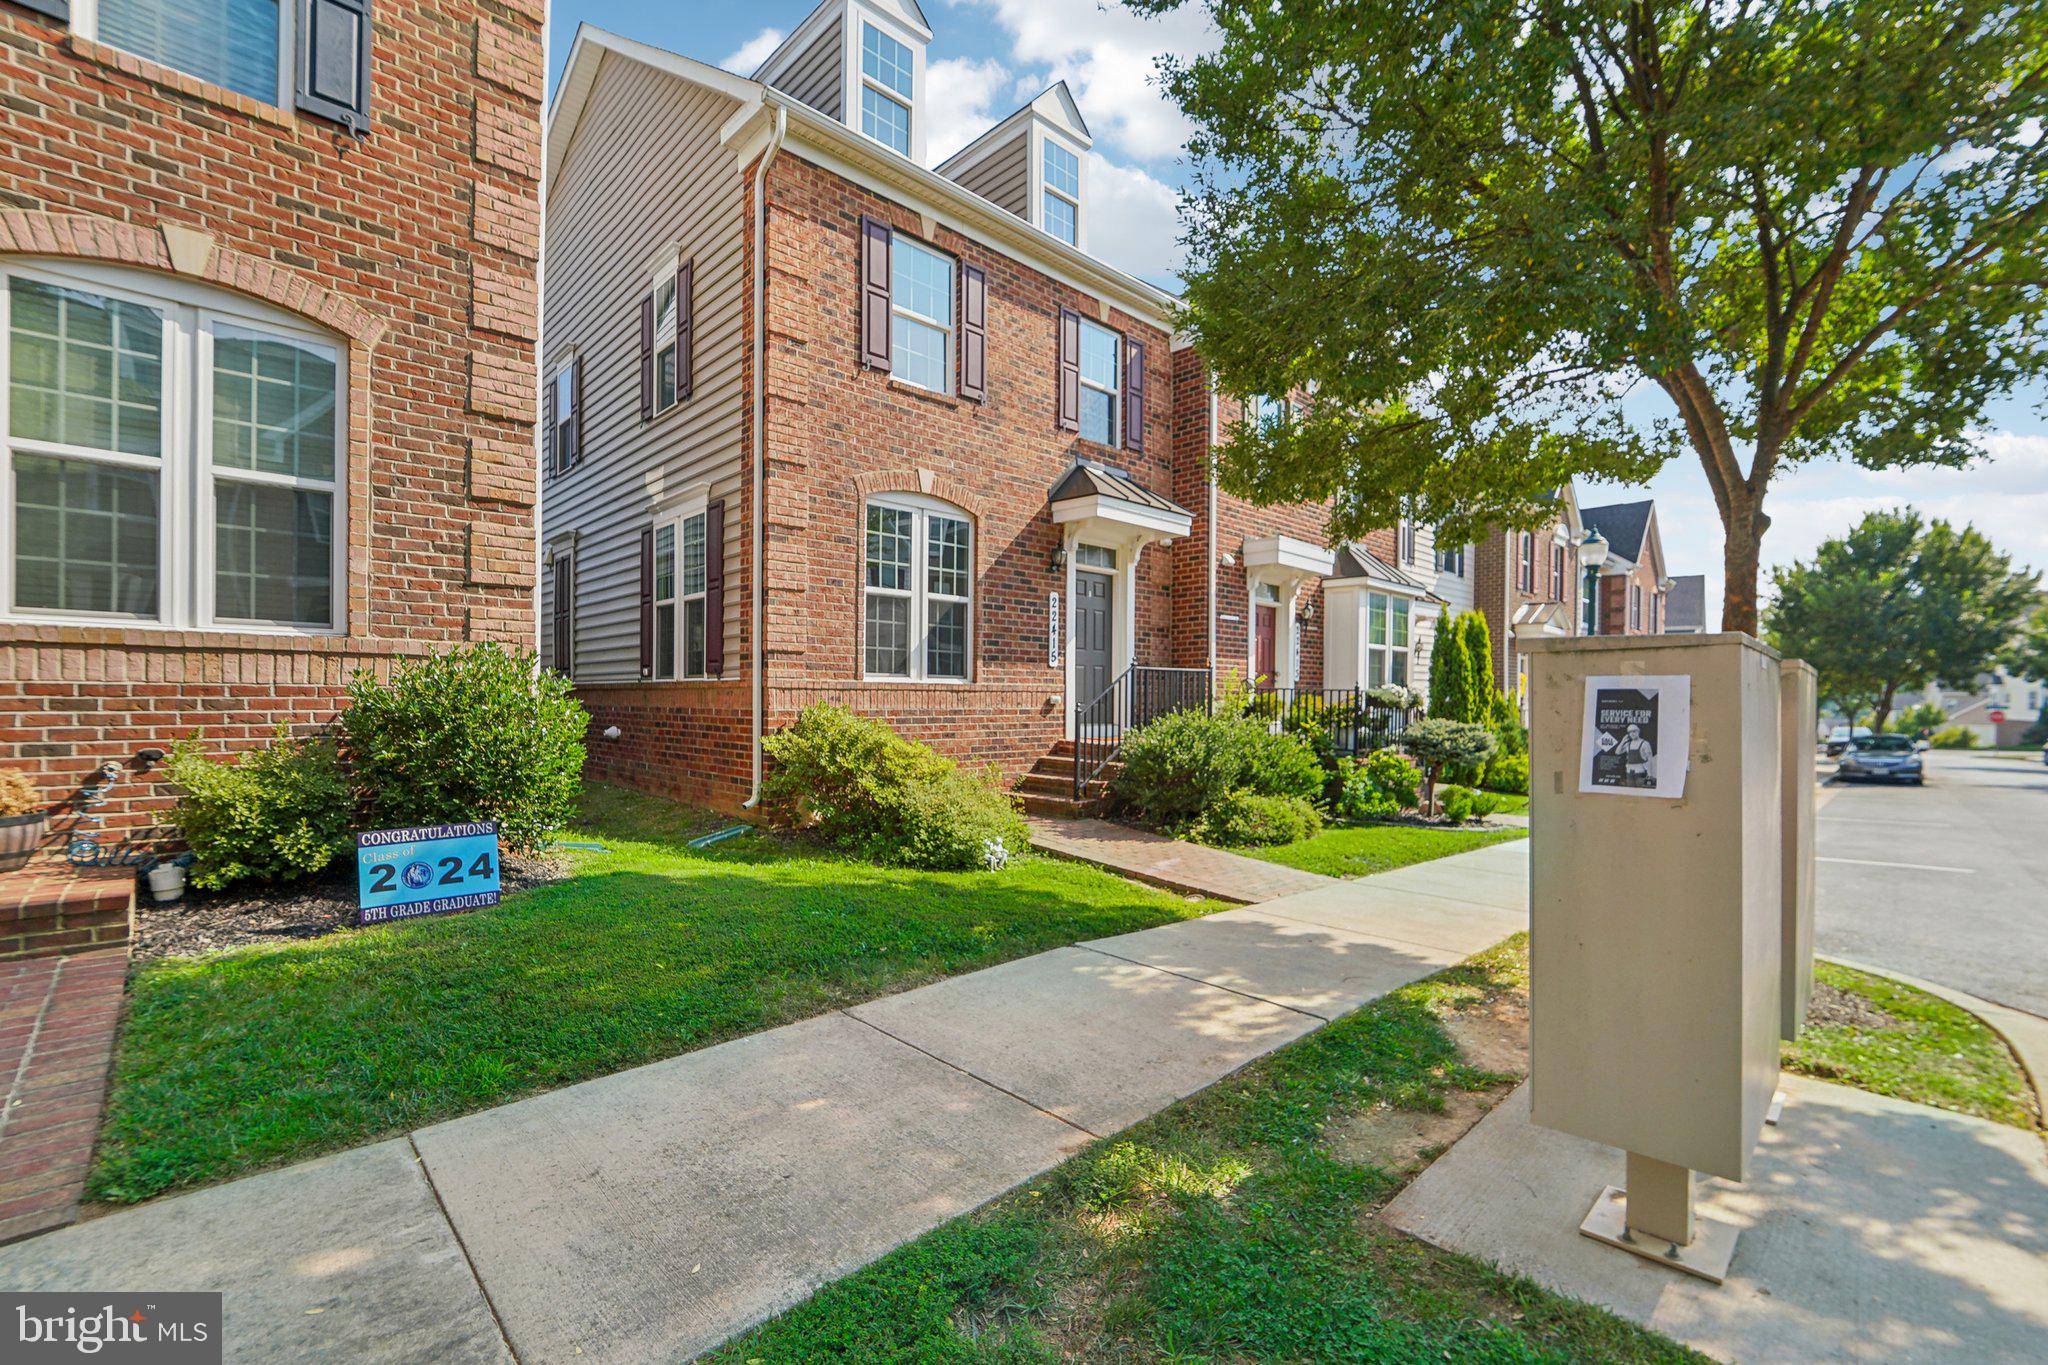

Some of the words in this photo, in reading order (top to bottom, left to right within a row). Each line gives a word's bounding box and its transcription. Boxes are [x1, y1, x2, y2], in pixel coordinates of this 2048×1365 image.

[1600, 709, 1633, 717] SERVICE
[1635, 709, 1652, 717] FOR
[1600, 716, 1626, 724] EVERY
[1627, 716, 1649, 724] NEED
[361, 822, 493, 846] CONGRATULATIONS
[362, 850, 398, 865] Class
[402, 845, 416, 857] of
[364, 907, 387, 922] 5TH
[390, 901, 431, 918] GRADE
[433, 892, 497, 912] GRADUATE!
